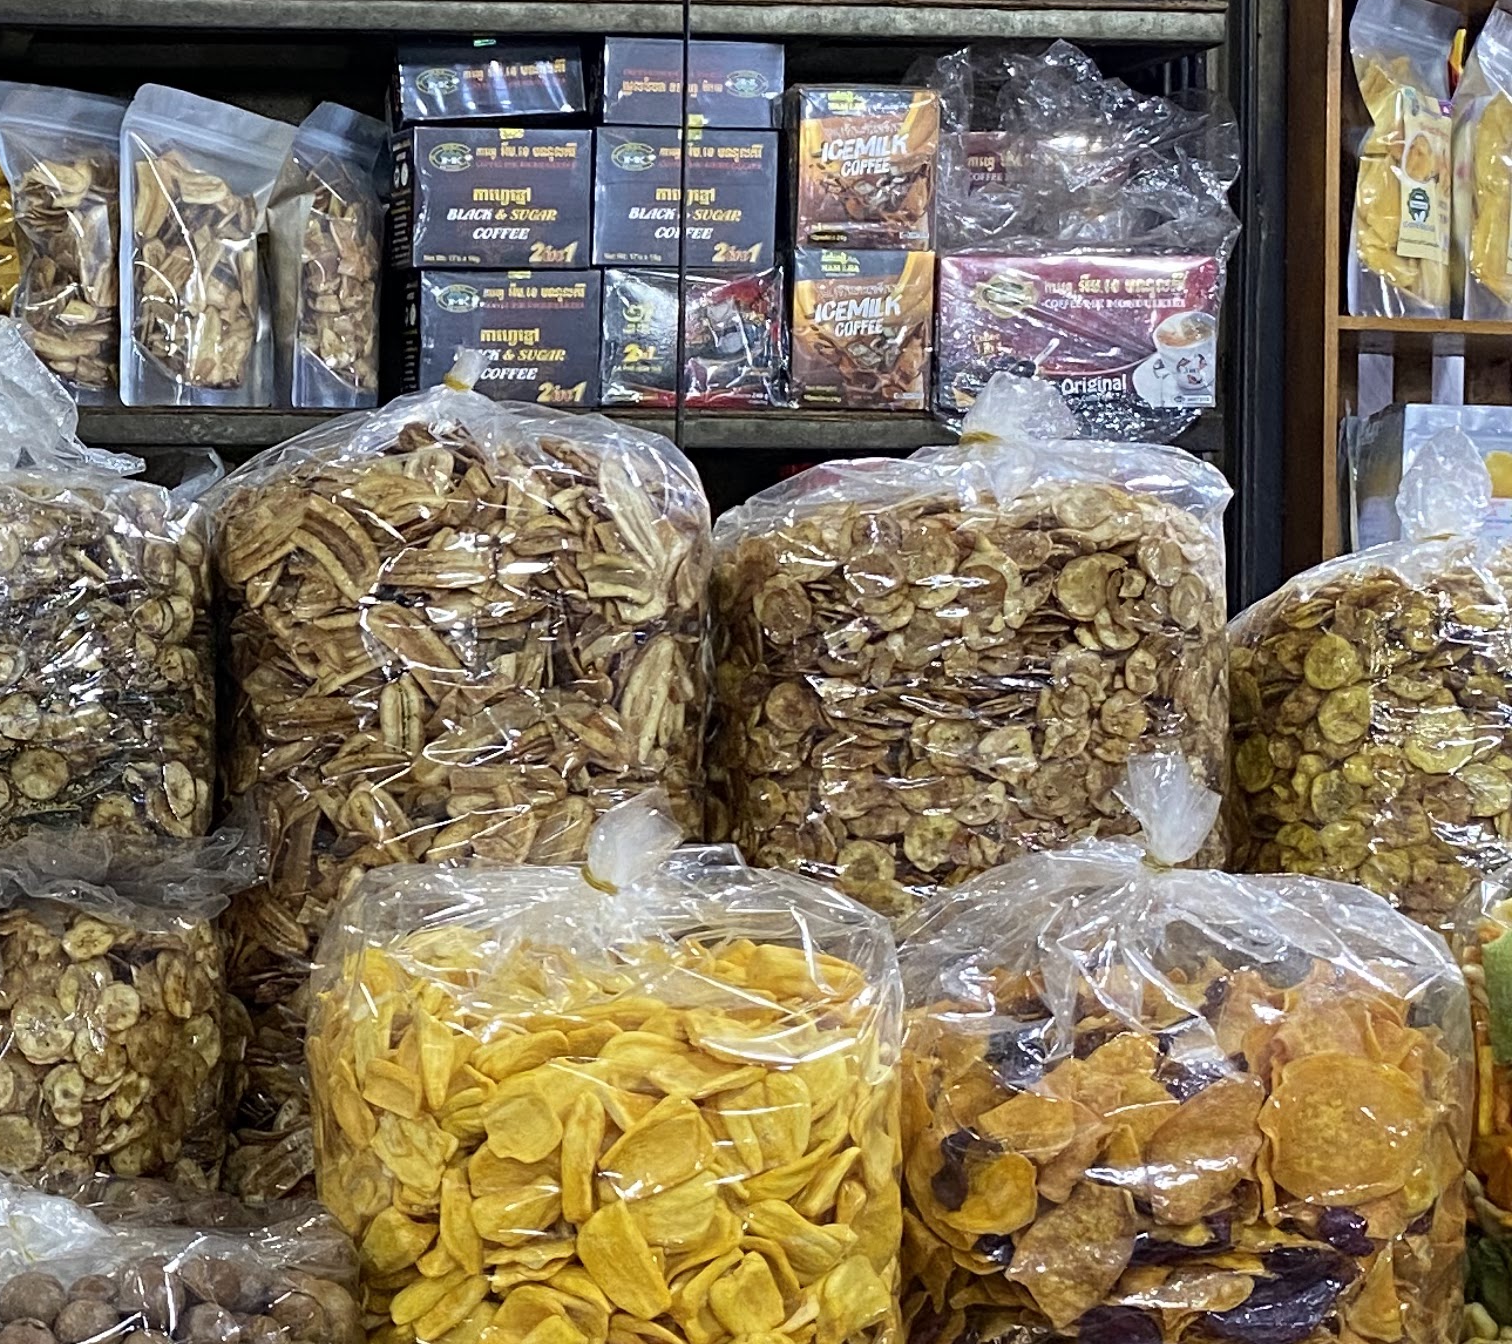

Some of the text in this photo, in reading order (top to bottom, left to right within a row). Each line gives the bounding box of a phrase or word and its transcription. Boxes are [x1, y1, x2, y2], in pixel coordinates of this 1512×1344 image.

[821, 133, 909, 164] ICEMILK
[841, 157, 891, 177] COFFEE
[447, 208, 558, 221] BLACK & SUGAR
[629, 207, 742, 222] BLACK SUGAR
[473, 227, 530, 240] COFFEE
[814, 294, 902, 324] ICEMILK
[835, 318, 884, 337] COFFEE
[502, 349, 515, 361] &
[517, 349, 567, 361] SUGAR
[480, 367, 538, 380] COFFEE
[1061, 374, 1128, 395] Original
